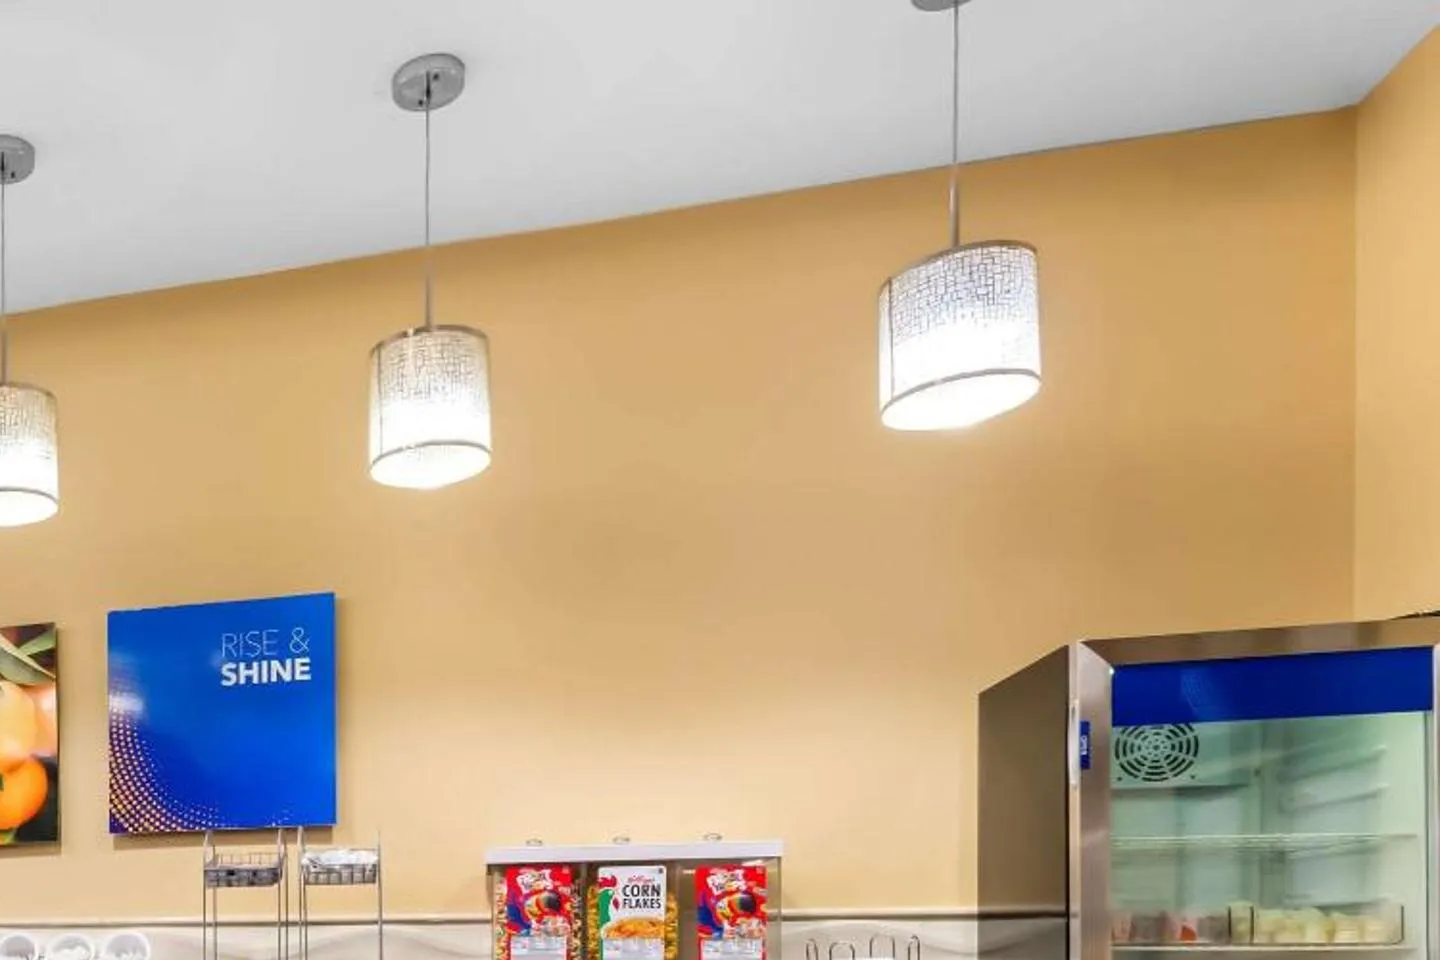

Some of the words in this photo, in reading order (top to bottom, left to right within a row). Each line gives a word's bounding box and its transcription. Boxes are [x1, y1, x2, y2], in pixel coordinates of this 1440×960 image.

[221, 630, 278, 657] RISE
[289, 627, 310, 654] &
[221, 657, 312, 687] SHINE
[622, 884, 661, 897] CORN
[623, 898, 662, 909] FLAKES
